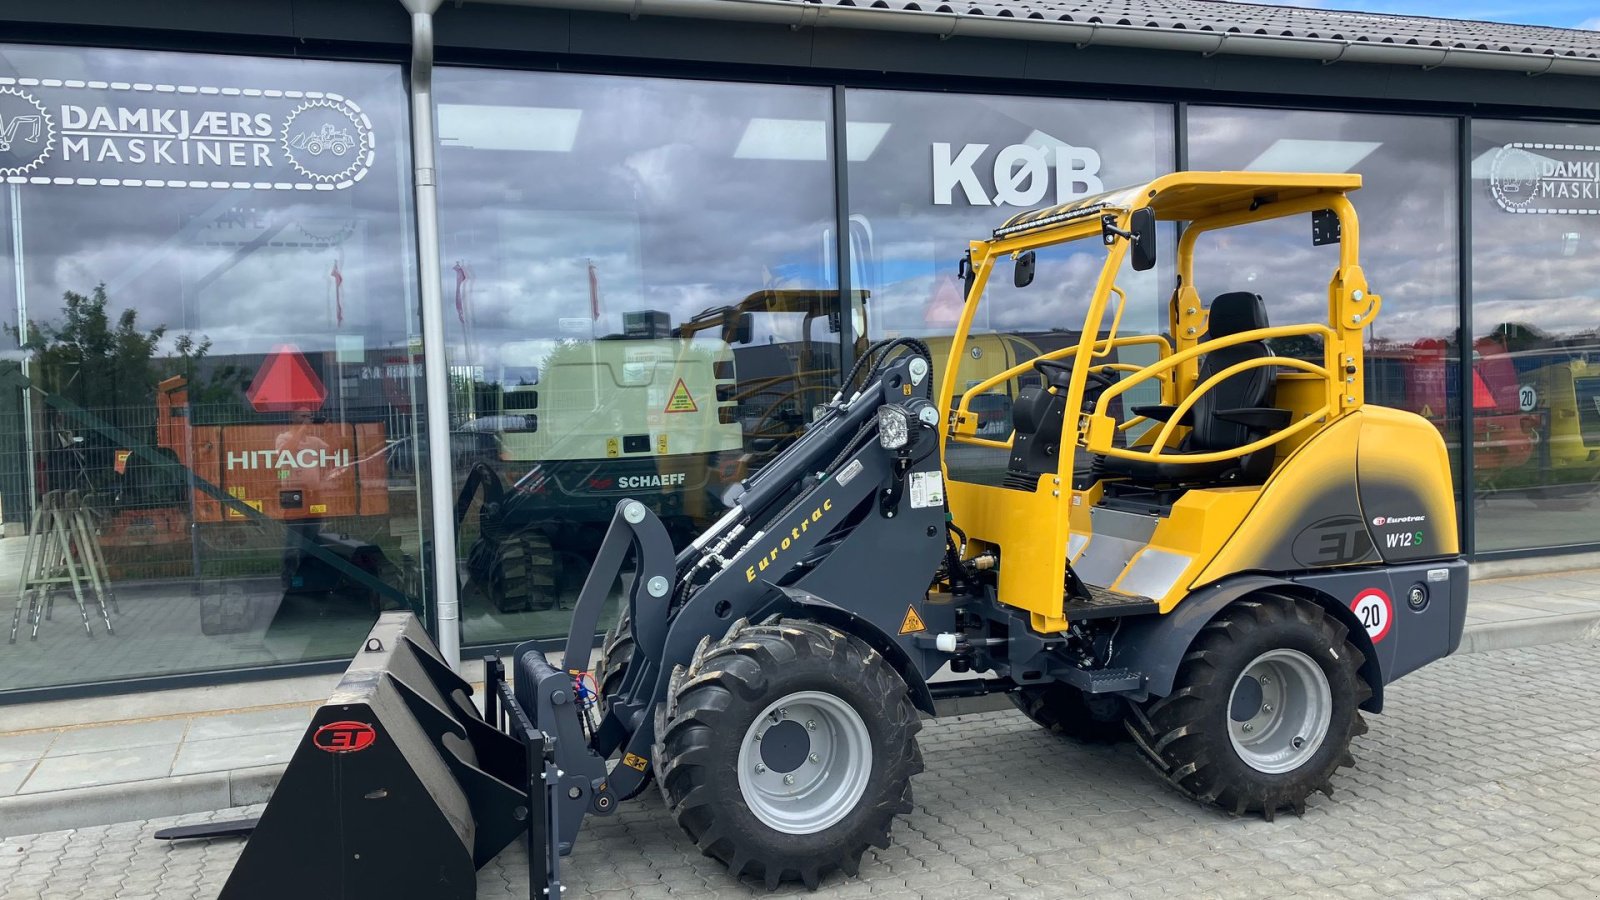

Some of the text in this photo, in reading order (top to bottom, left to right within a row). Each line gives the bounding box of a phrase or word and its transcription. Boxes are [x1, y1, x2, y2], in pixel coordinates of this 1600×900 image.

[61, 105, 273, 140] DAMKJÆRS
[62, 137, 273, 167] MASKINER
[932, 142, 1103, 207] KØB
[1542, 182, 1599, 198] MASKI
[1521, 390, 1533, 407] 20
[227, 448, 349, 470] HITACHI
[618, 473, 686, 488] SCHAEFF
[1387, 515, 1426, 524] Eurotrac
[745, 498, 832, 583] Eurotrac
[1386, 531, 1423, 548] W12 S
[1361, 604, 1380, 629] 20
